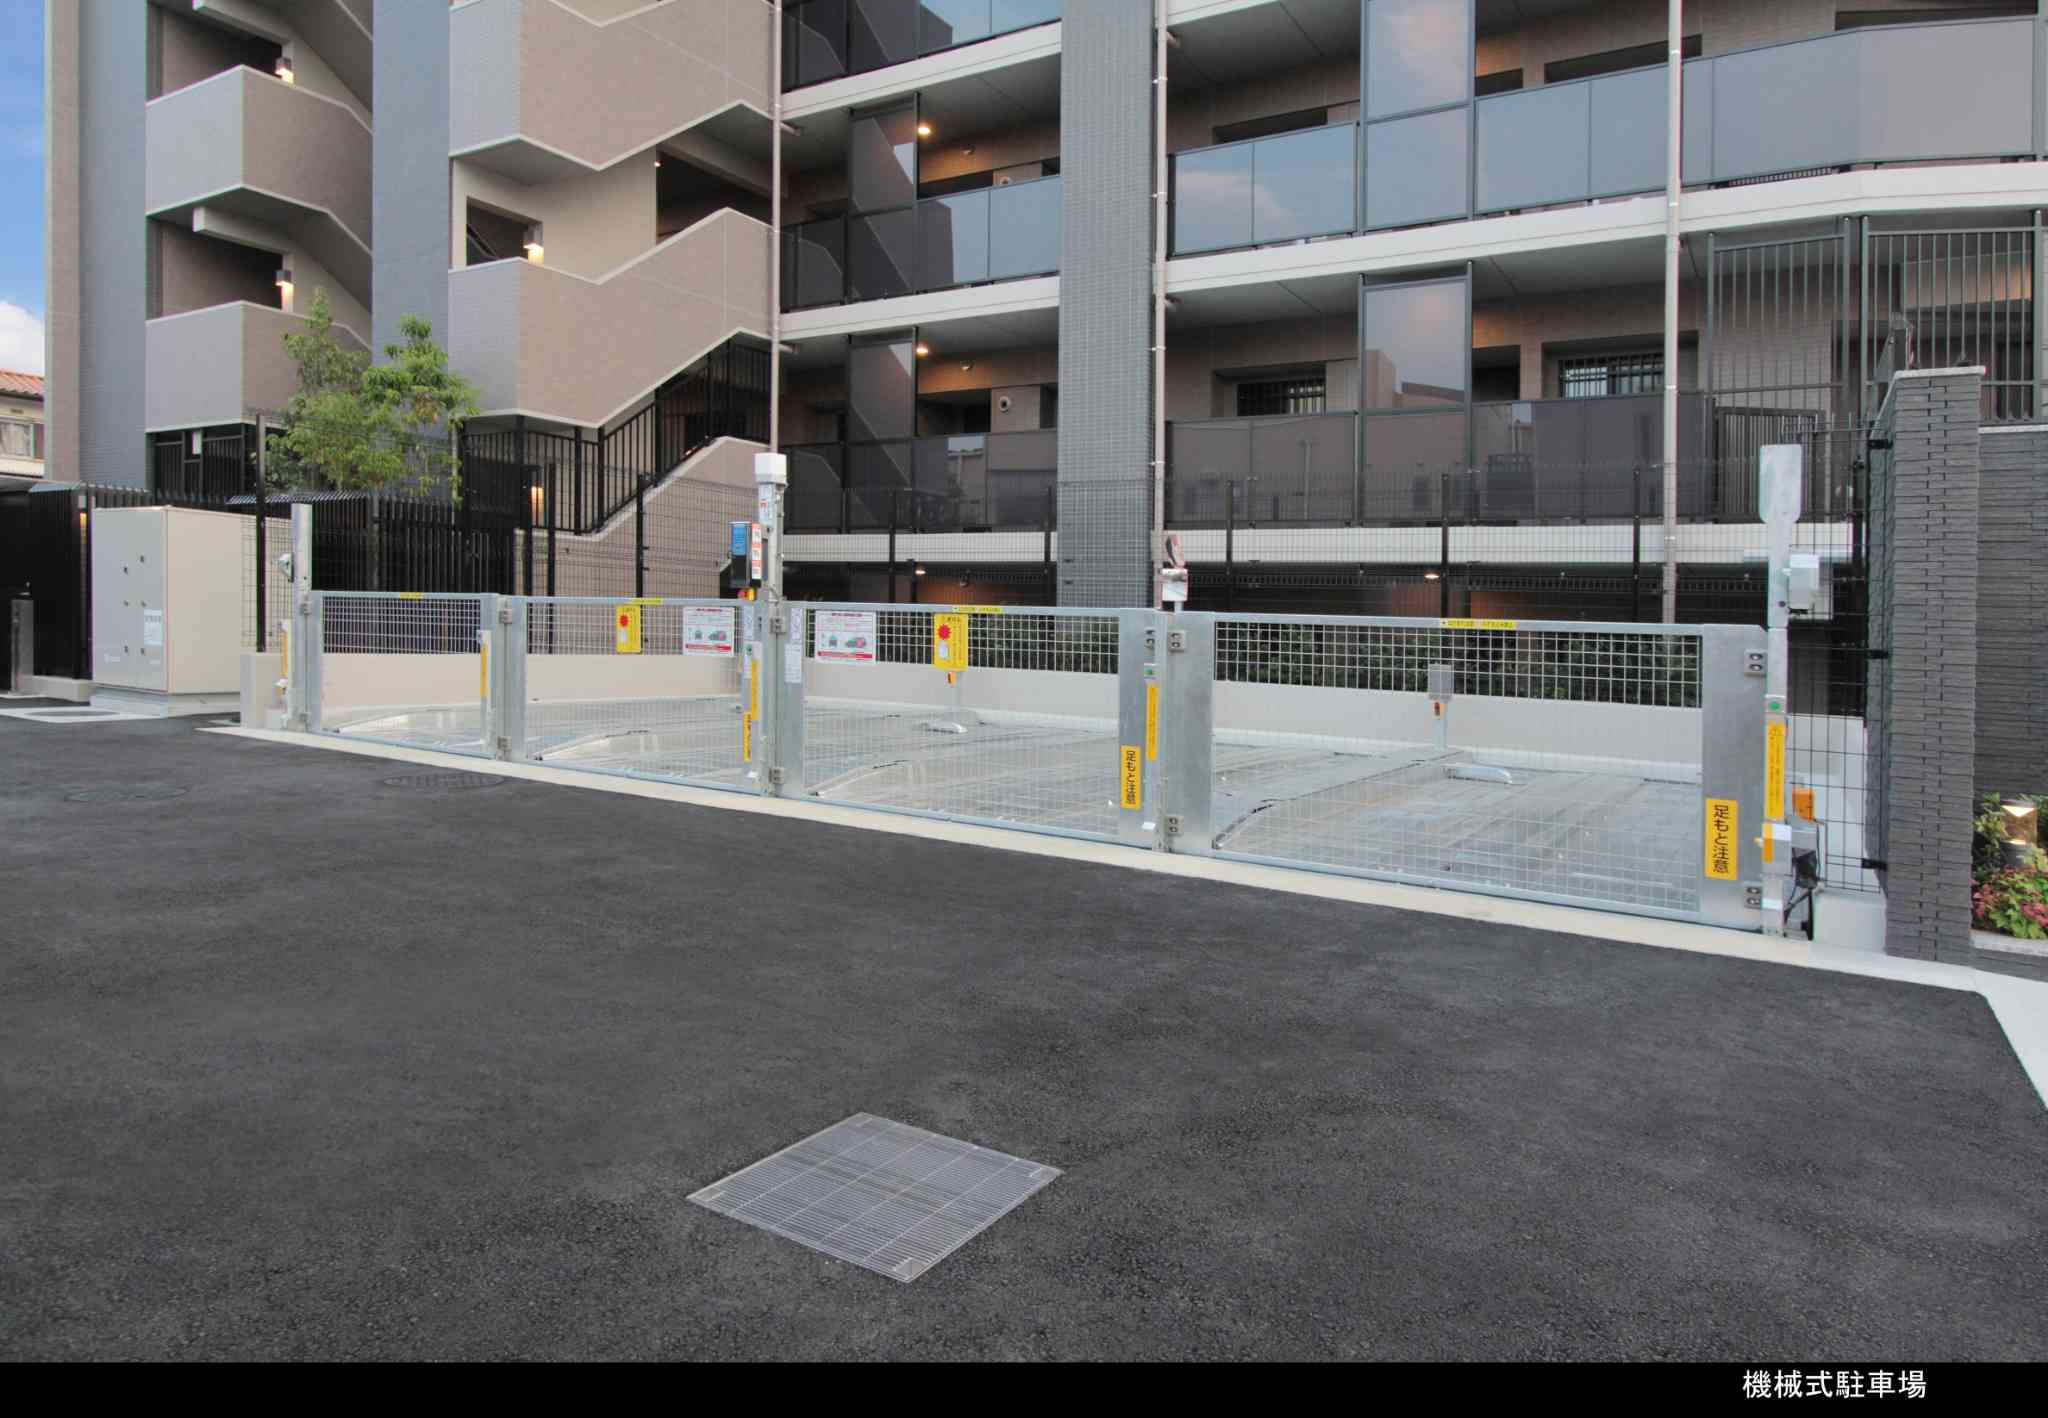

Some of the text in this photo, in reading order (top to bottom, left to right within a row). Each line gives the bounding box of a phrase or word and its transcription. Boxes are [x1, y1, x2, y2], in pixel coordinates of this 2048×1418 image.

[1713, 805, 1730, 874] 足もと注意
